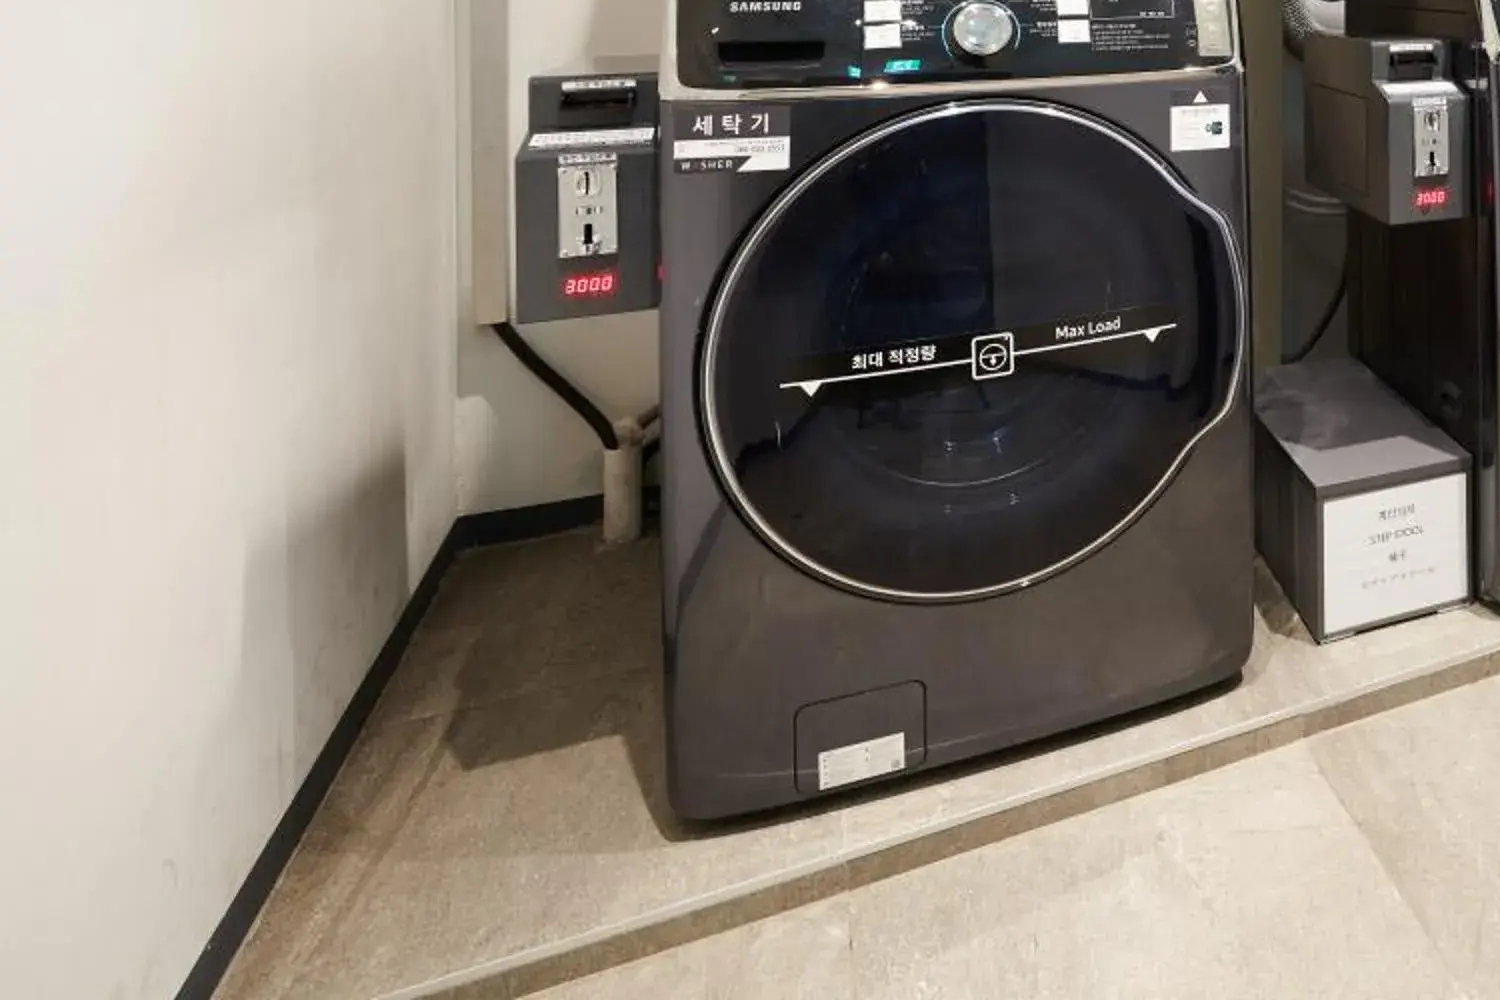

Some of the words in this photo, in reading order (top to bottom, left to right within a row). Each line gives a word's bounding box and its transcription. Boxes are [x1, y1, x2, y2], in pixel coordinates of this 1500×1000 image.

[729, 0, 802, 12] SAMSUNG
[693, 113, 769, 135] 세탁기
[565, 276, 613, 295] 3000
[1056, 325, 1085, 340] Max
[1089, 317, 1121, 334] Load
[852, 351, 883, 370] 최대
